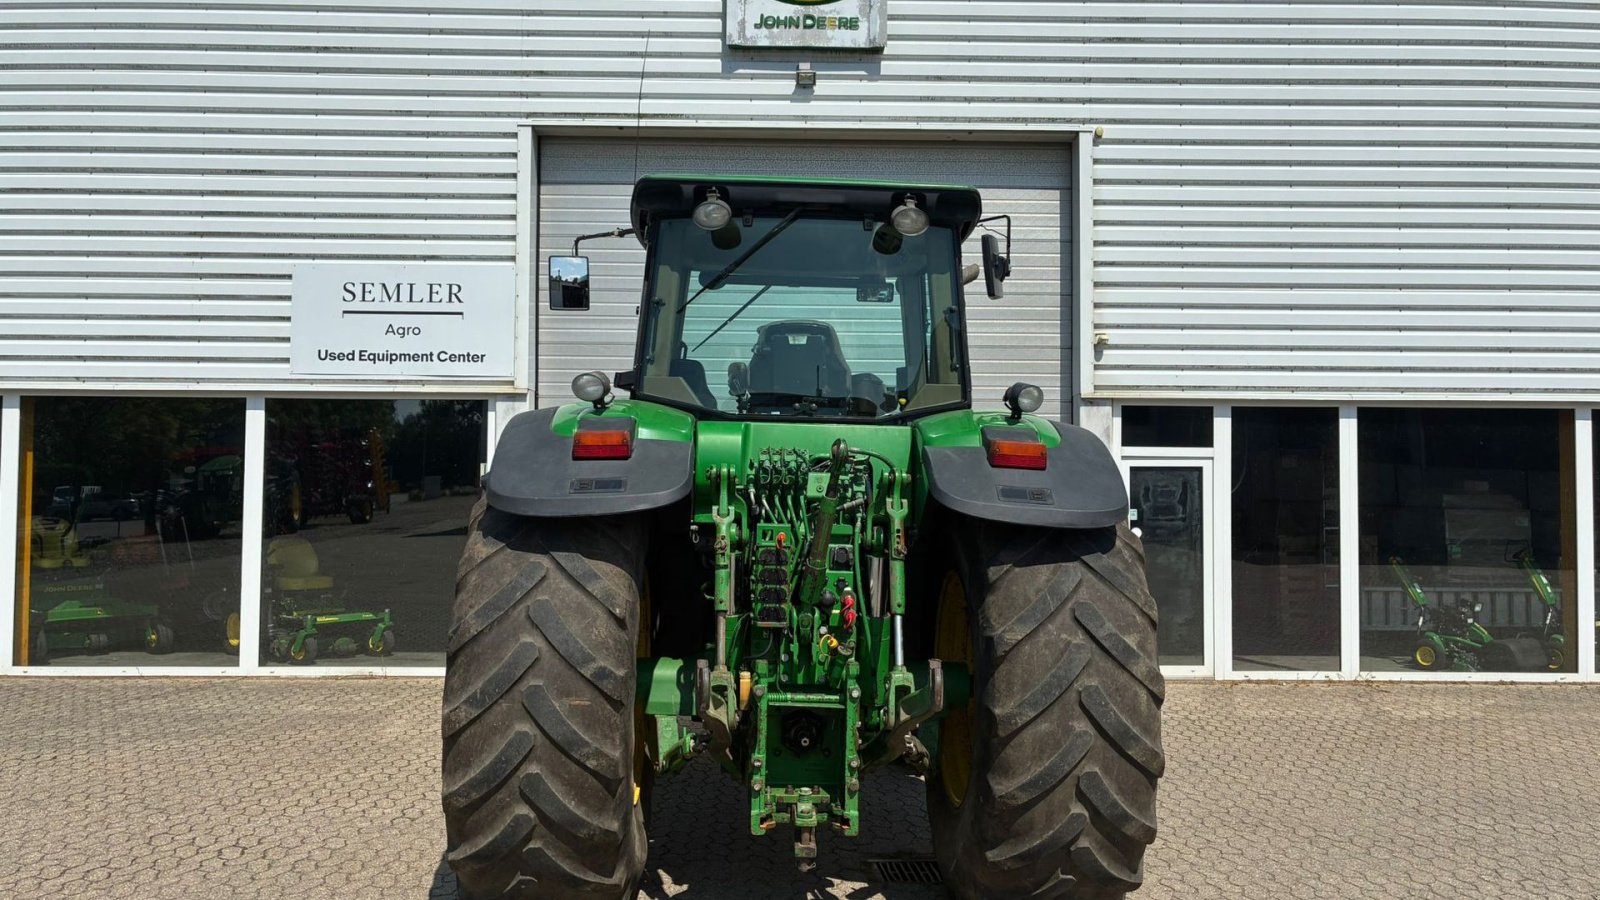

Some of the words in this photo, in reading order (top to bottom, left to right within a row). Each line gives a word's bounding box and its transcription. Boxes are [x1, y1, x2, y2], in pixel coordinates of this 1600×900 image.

[754, 13, 799, 30] JOHN
[803, 14, 859, 30] DEERE
[342, 281, 464, 303] SEMLER
[385, 324, 421, 339] Agro
[317, 349, 355, 362] Used
[358, 350, 434, 364] Equipment
[436, 351, 486, 363] Center
